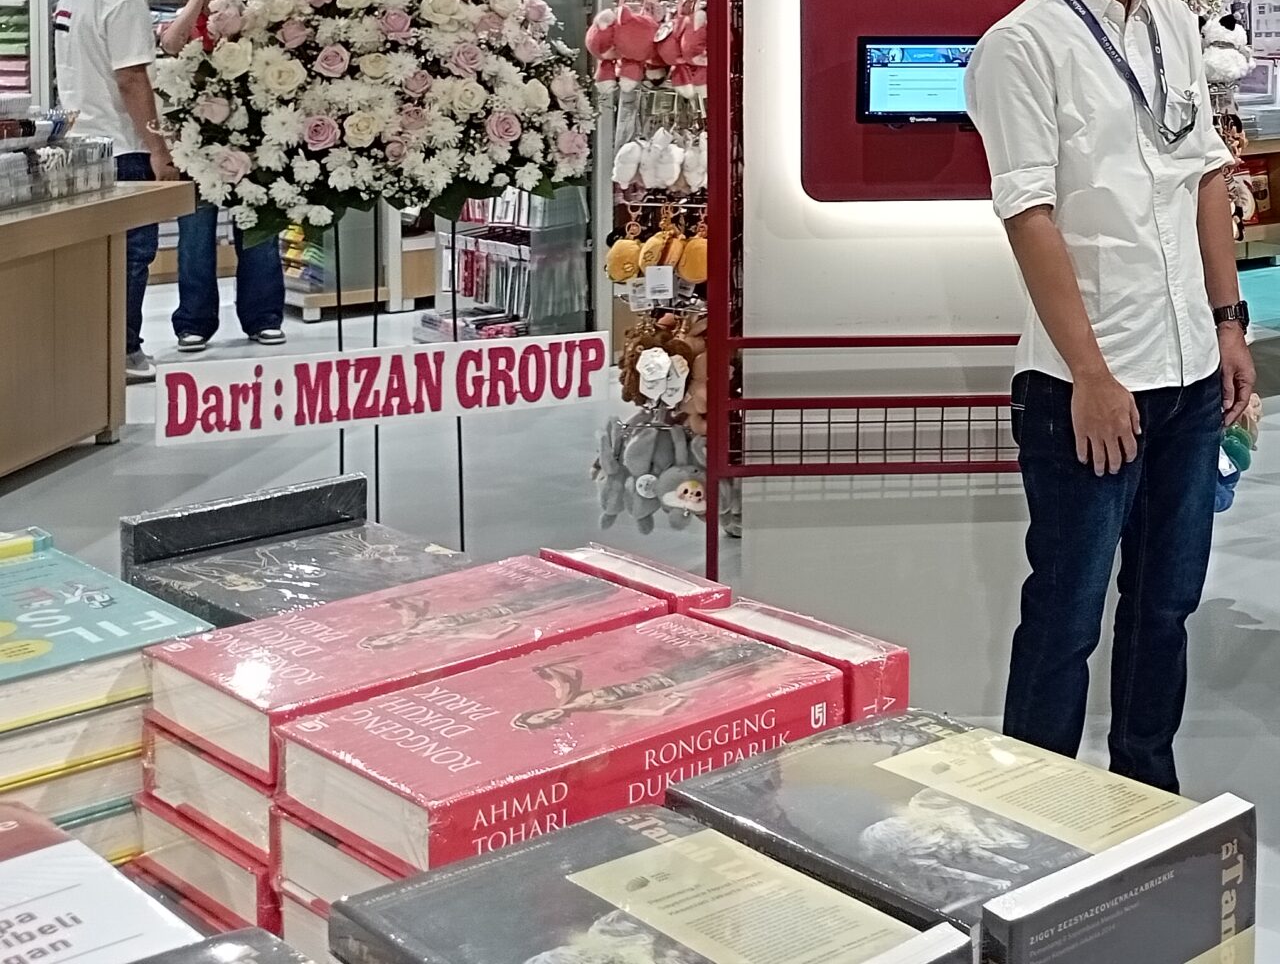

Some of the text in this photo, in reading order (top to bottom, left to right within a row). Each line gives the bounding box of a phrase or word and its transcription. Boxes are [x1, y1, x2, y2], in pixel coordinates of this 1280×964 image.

[294, 352, 446, 426] MIZAN
[456, 336, 606, 409] GROUP
[237, 624, 323, 658] DUKUH
[277, 614, 349, 644] PARUK
[377, 697, 475, 739] DUKUH
[413, 685, 501, 722] PARUK
[343, 707, 482, 773] RONGGENG
[643, 708, 777, 771] RONGGENG
[627, 756, 714, 805] DUKUH
[471, 781, 569, 831] AHMAD
[471, 808, 570, 856] TOHARI
[1221, 839, 1239, 861] Di
[1029, 928, 1055, 946] ZIGGY
